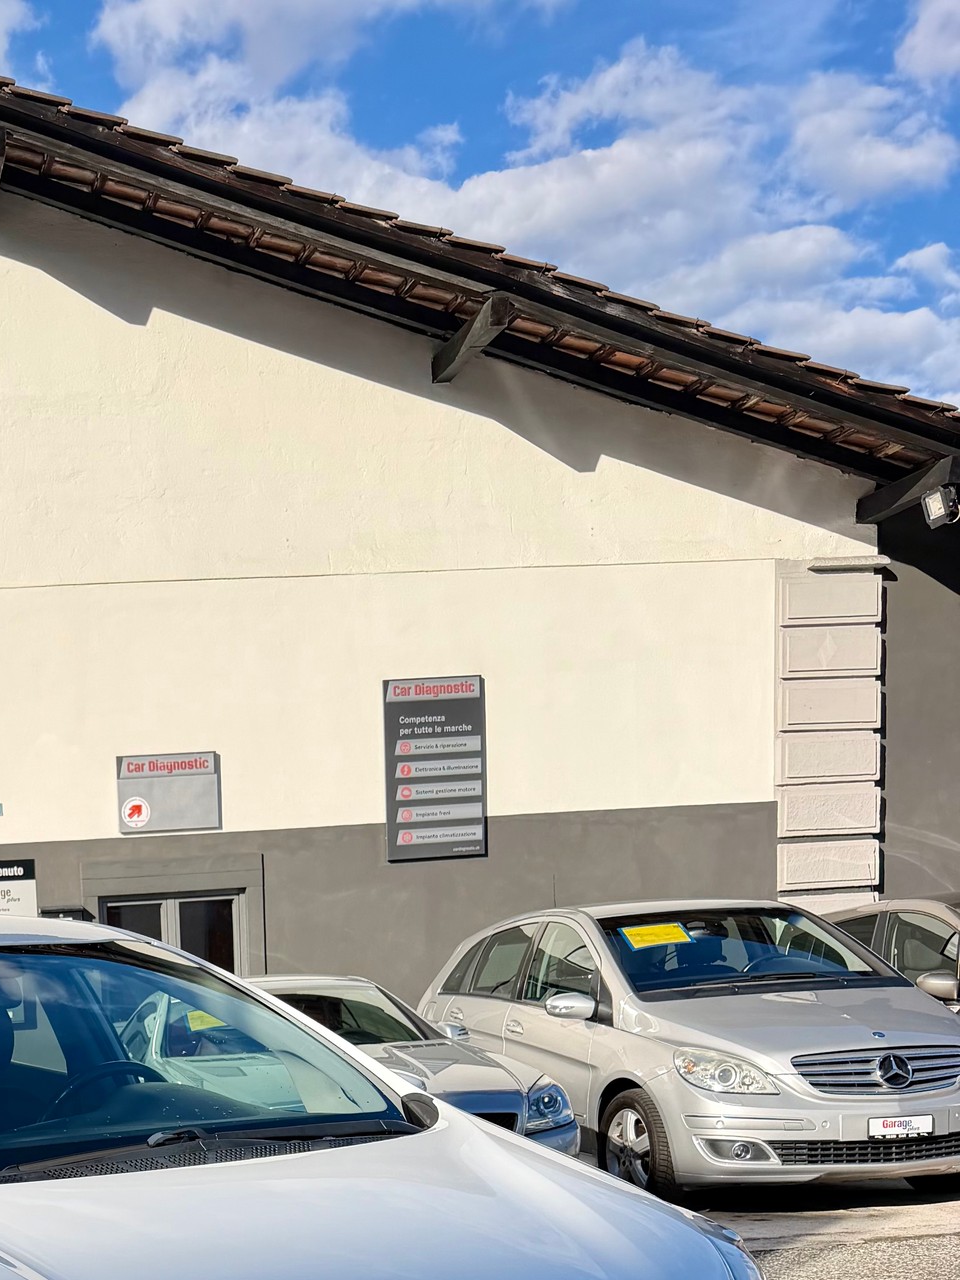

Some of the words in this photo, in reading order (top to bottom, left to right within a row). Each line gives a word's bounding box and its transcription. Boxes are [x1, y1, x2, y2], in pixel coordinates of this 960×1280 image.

[393, 685, 411, 697] Car
[414, 681, 475, 697] Diagnostic
[399, 715, 445, 725] Competenza
[400, 728, 412, 736] per
[414, 726, 433, 734] tutte
[444, 724, 472, 732] marche
[126, 761, 146, 773] Car
[148, 757, 209, 774] Diagnostic
[6, 896, 21, 904] plus
[882, 1119, 913, 1130] Garage
